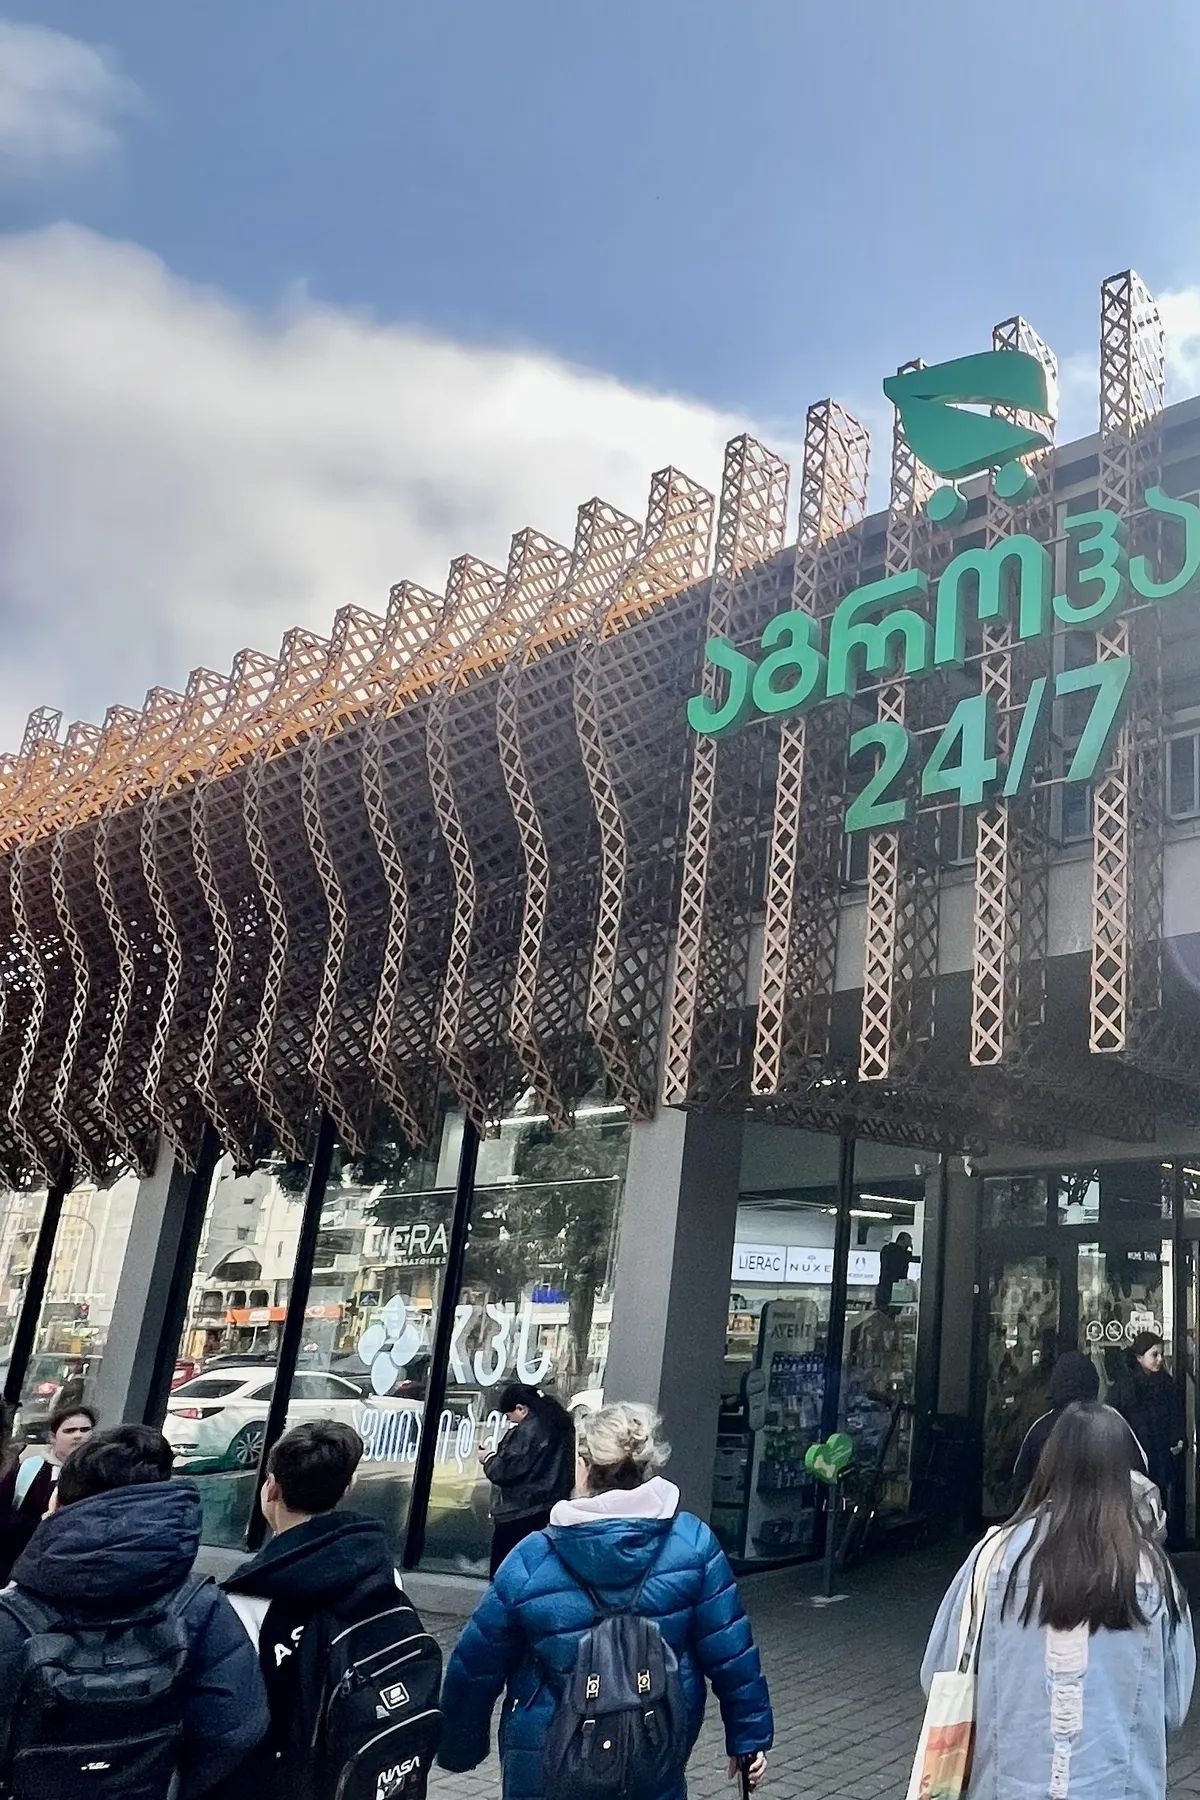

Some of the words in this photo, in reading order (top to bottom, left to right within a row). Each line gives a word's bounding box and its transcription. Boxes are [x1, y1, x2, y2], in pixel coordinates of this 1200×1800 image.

[845, 656, 1132, 834] 24/7
[739, 1255, 781, 1272] LIERAC
[789, 1263, 832, 1273] NUXE
[376, 1755, 421, 1787] NASA
